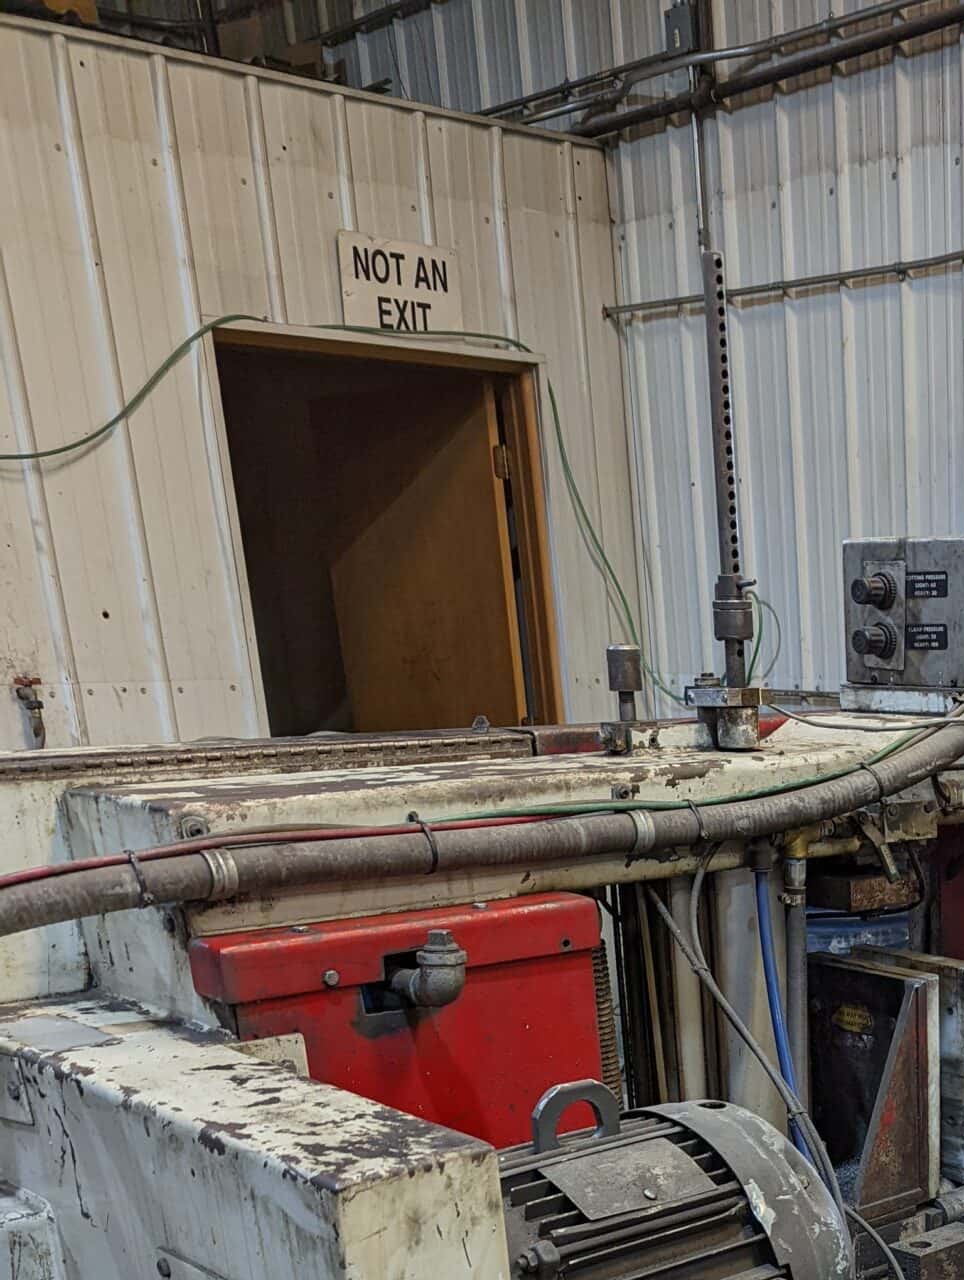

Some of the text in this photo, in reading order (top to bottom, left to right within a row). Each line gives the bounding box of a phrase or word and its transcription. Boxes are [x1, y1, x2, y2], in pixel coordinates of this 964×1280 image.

[352, 245, 448, 293] NOT AN
[377, 295, 432, 331] EXIT
